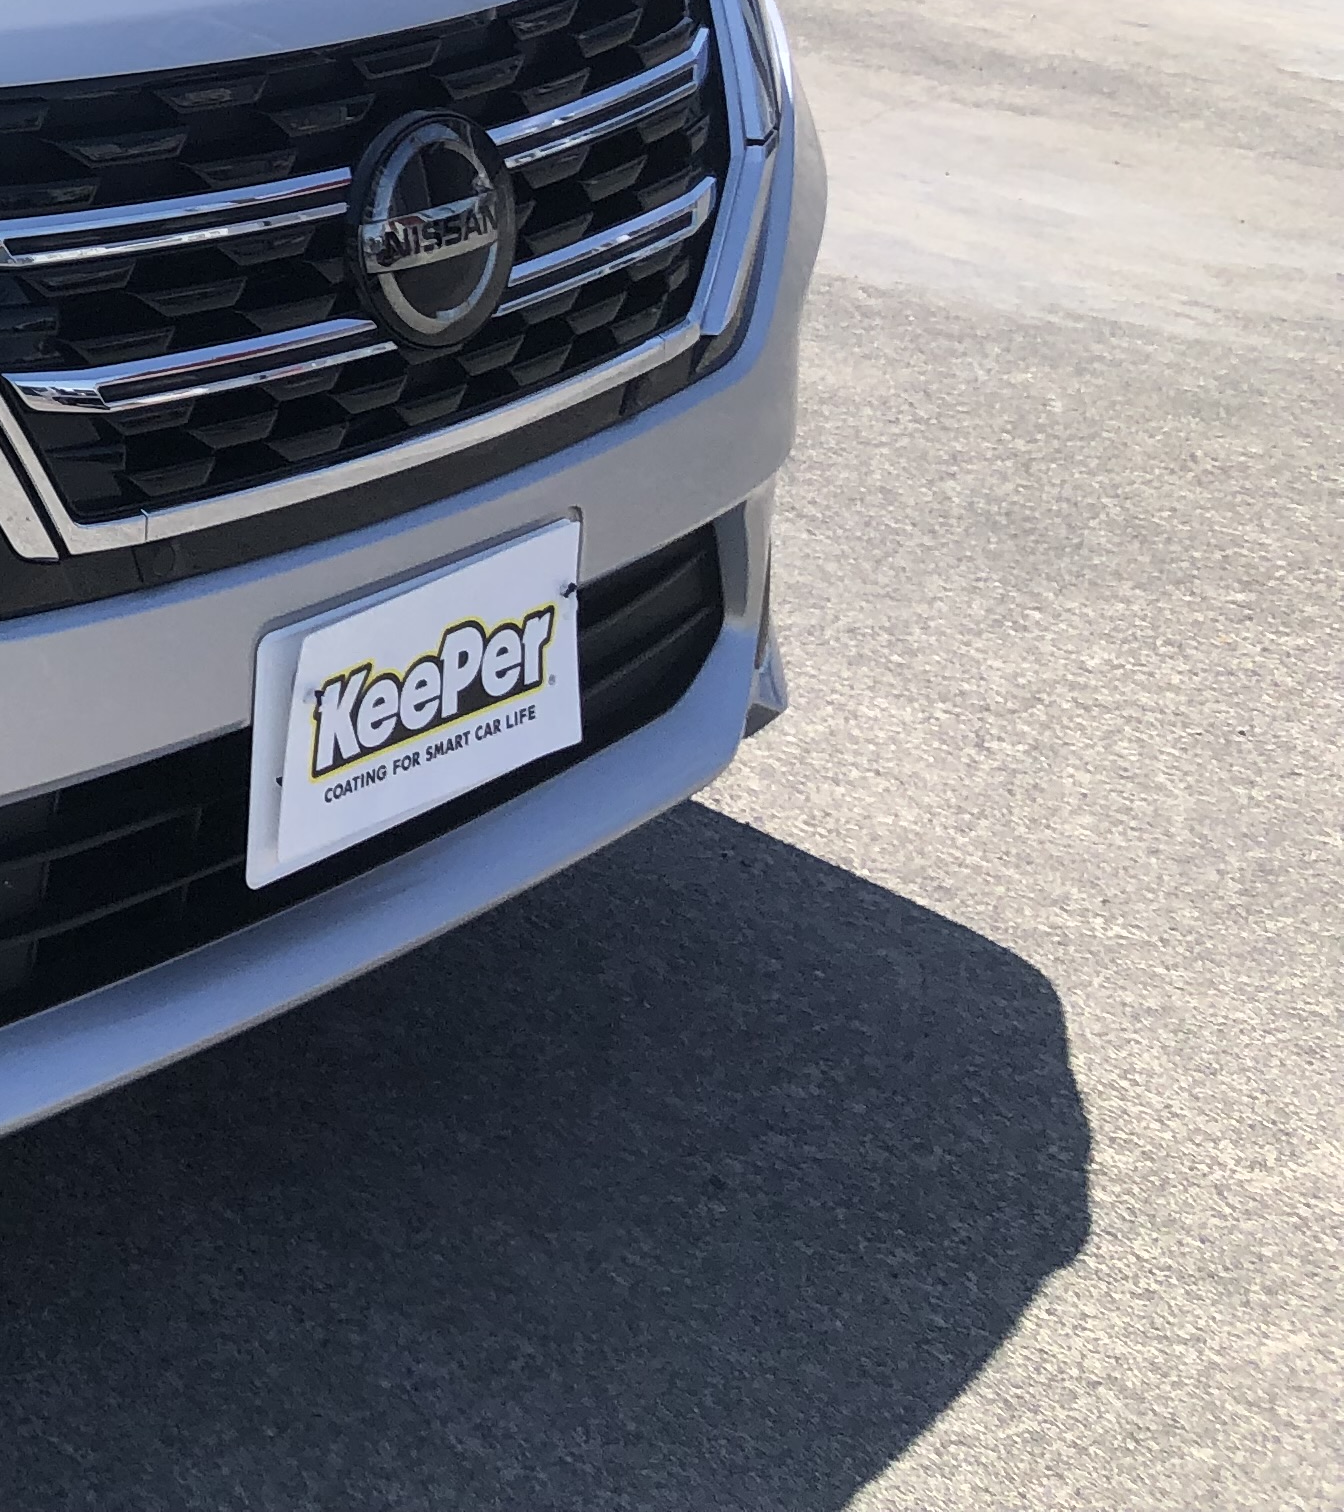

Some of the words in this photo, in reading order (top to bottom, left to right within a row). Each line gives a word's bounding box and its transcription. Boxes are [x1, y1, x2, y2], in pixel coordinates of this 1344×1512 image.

[383, 203, 498, 258] NISSAN
[313, 605, 556, 778] KeePer
[323, 764, 388, 804] COATING
[392, 751, 421, 776] FOR
[425, 730, 471, 763] SMART
[474, 718, 502, 741] CAR
[505, 704, 537, 728] LIFE
